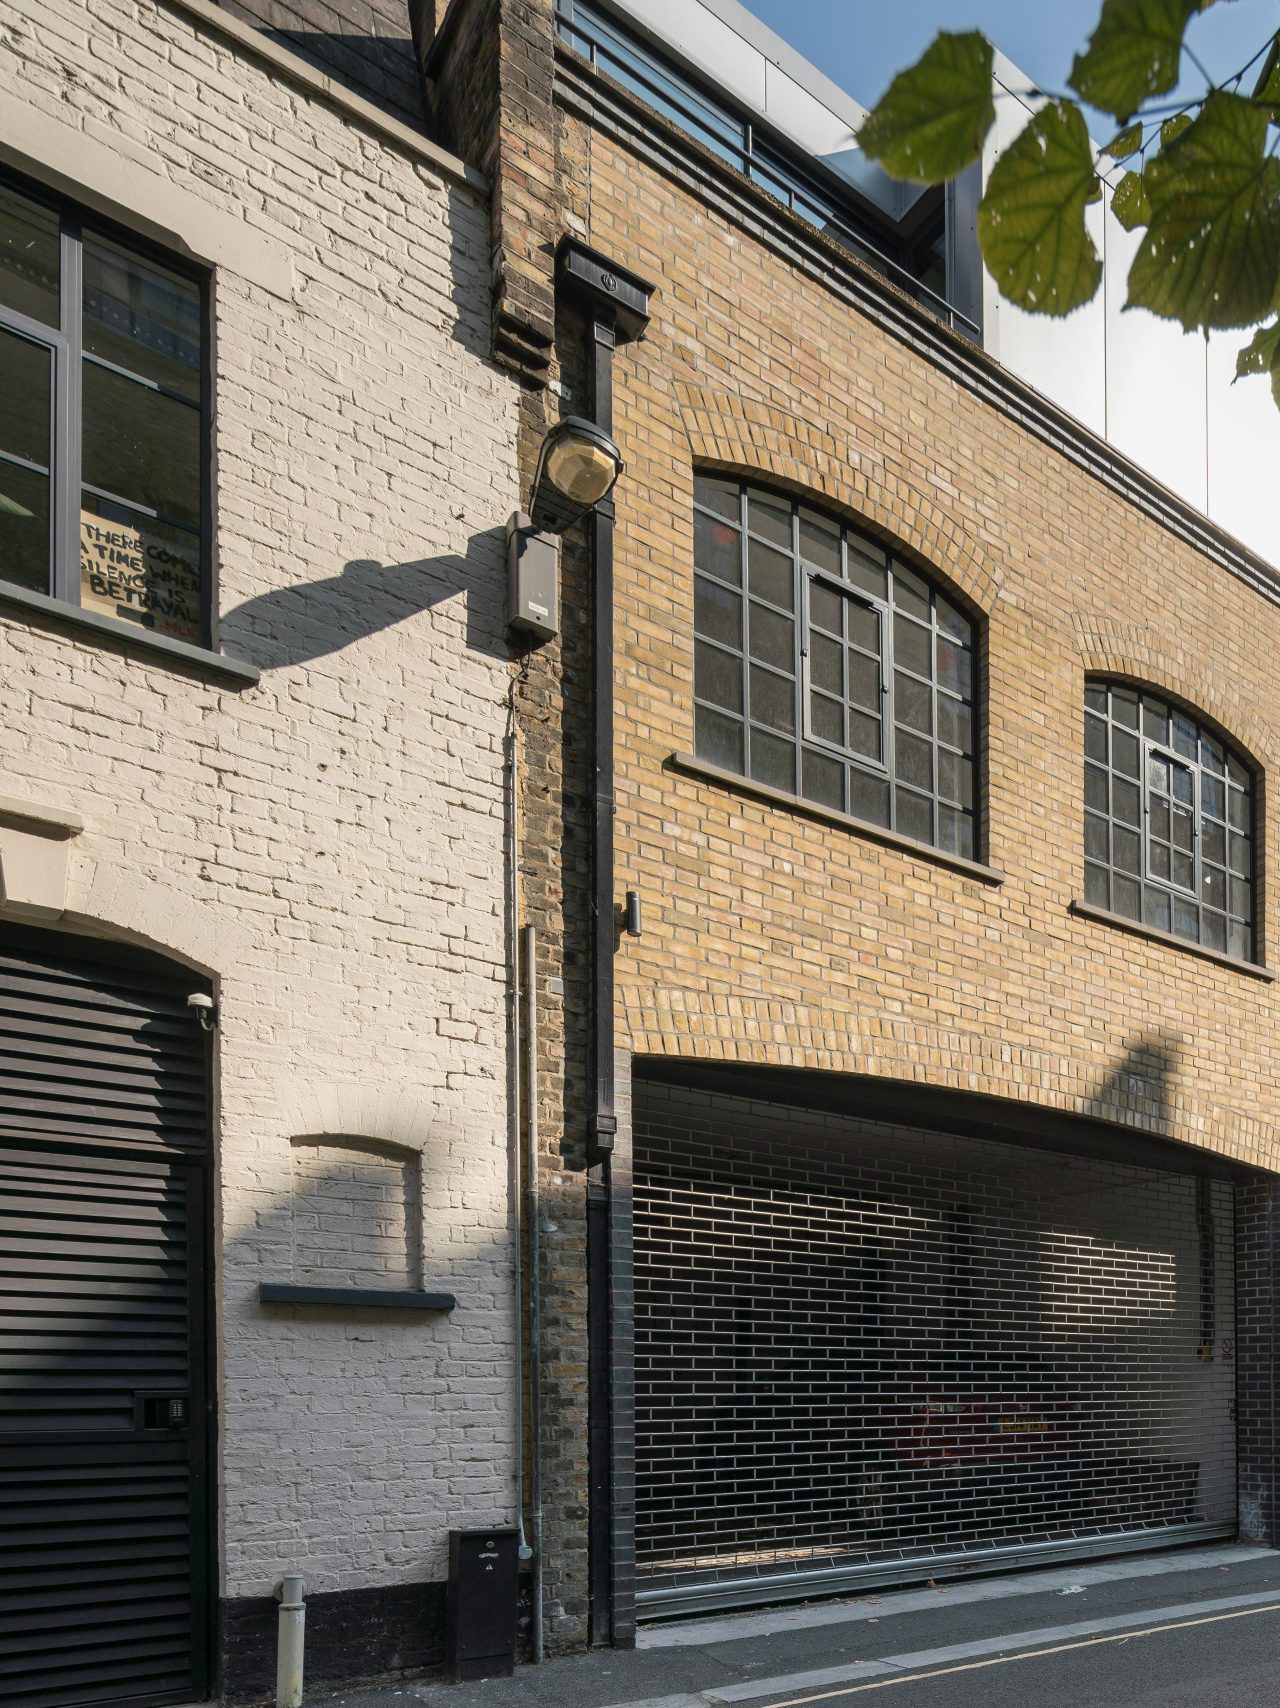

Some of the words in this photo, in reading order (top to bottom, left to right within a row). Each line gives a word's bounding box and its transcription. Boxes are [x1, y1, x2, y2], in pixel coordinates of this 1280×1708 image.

[80, 522, 145, 554] THERE
[92, 543, 144, 573] TIME
[89, 574, 199, 624] BETRAYAL
[167, 588, 186, 604] IS
